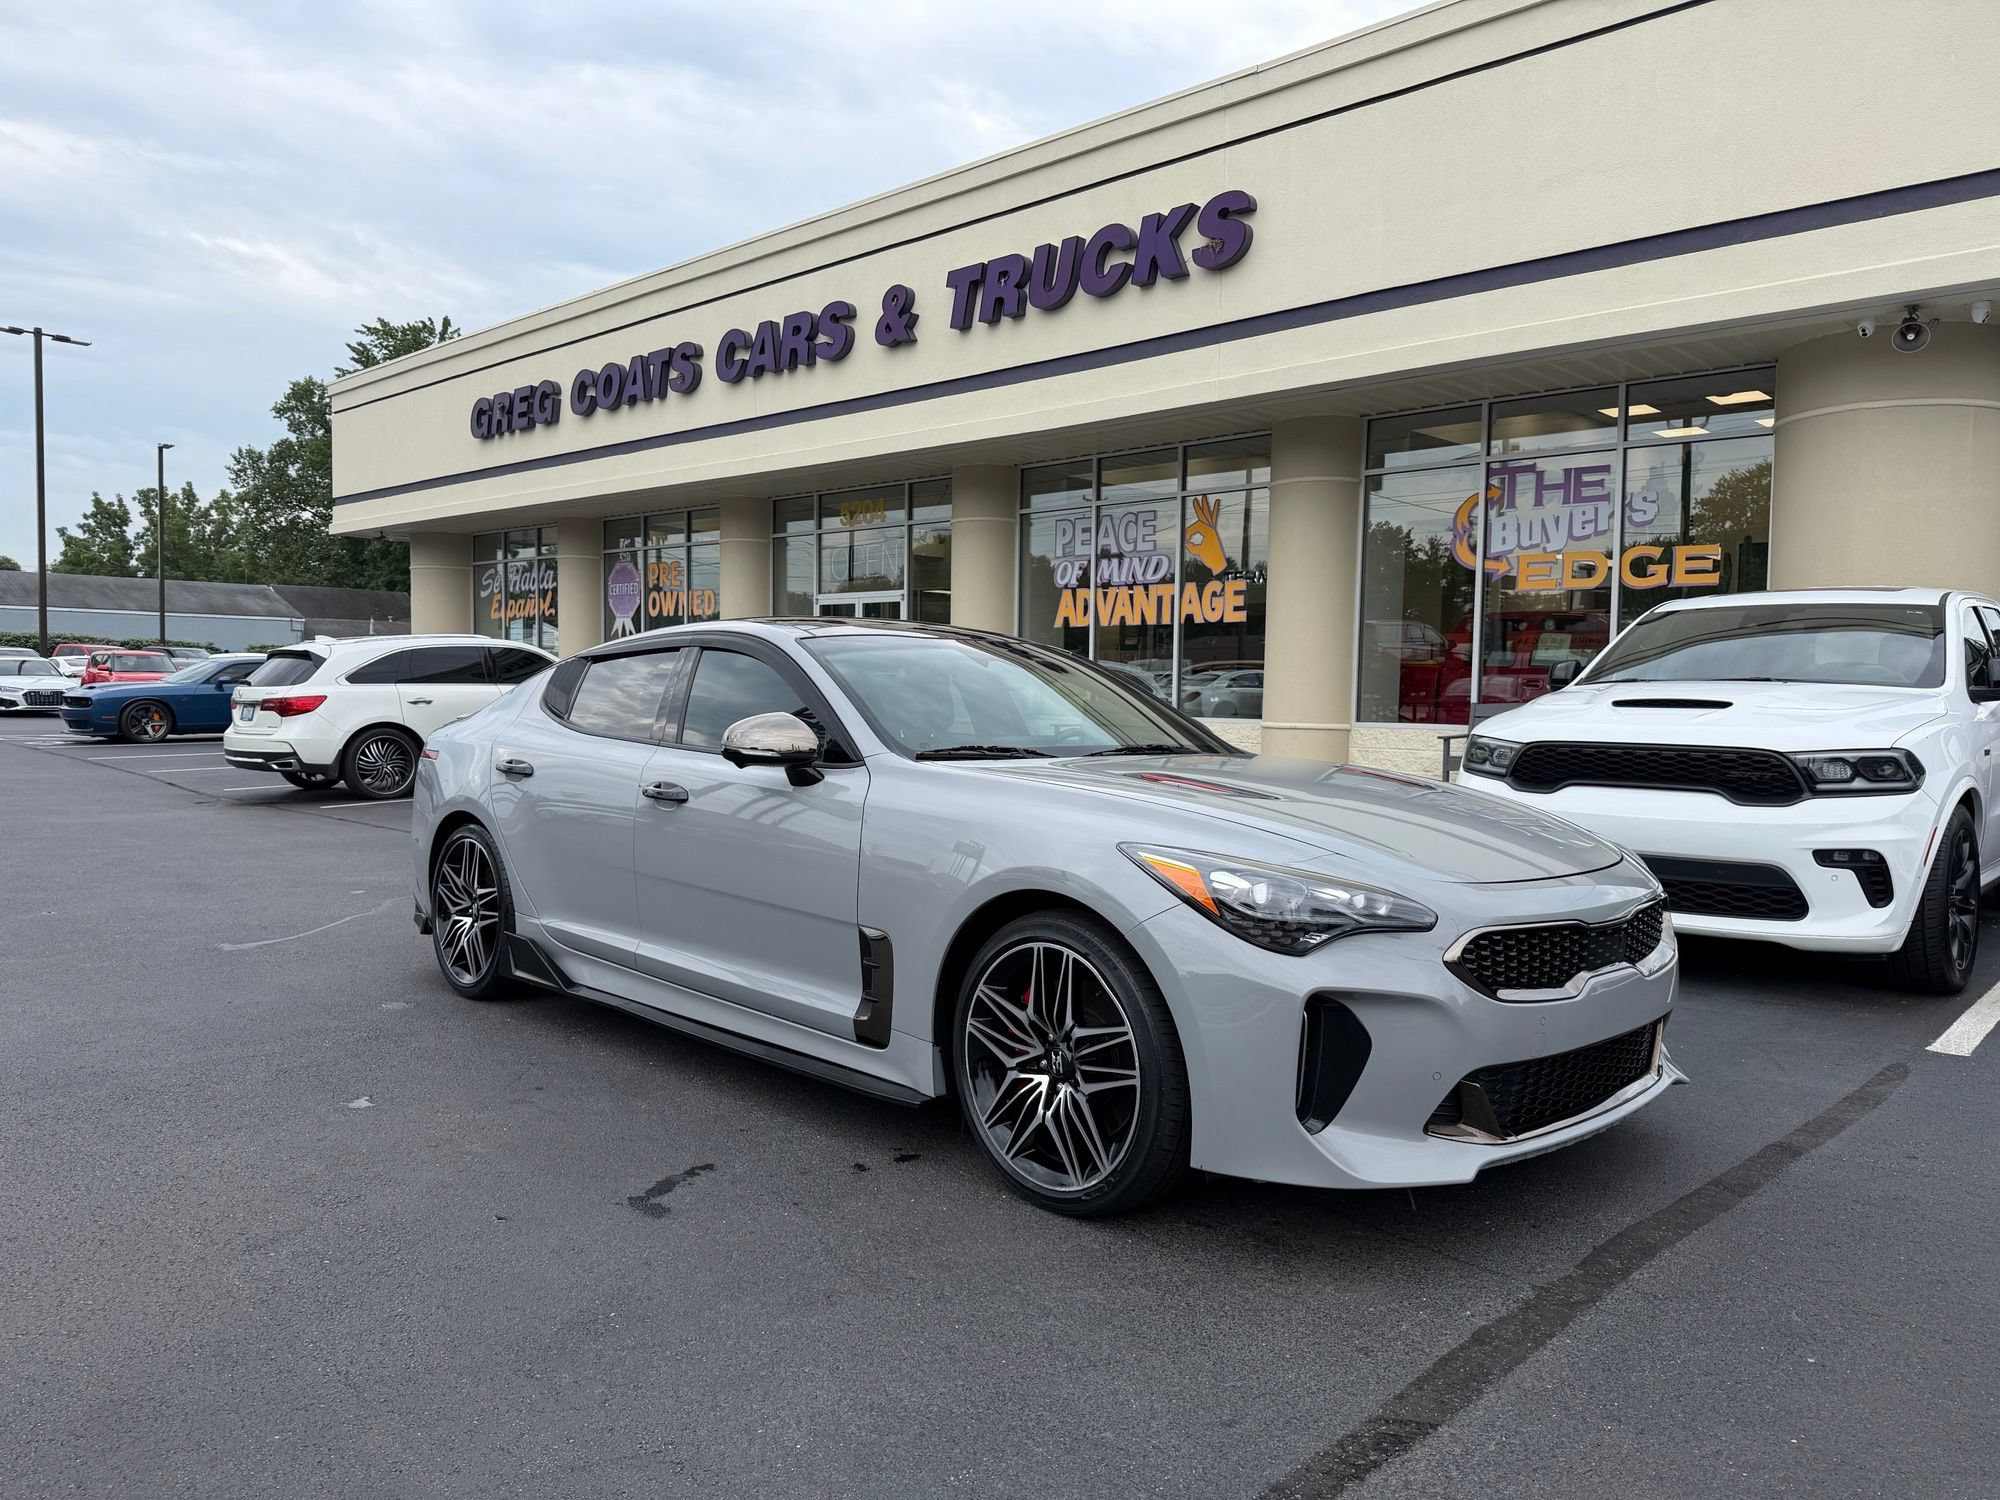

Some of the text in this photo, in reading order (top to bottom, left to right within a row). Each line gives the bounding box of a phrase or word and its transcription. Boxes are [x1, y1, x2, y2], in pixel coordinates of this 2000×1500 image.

[470, 189, 1258, 440] GREG COATS CARS & TRUCKS
[1488, 462, 1612, 510] THE
[1054, 510, 1157, 558] PEACE
[480, 562, 557, 598] Se Habla
[609, 582, 639, 596] CERTIFIED
[1052, 554, 1169, 588] OF MIND
[1515, 543, 1722, 592] EDGE
[648, 590, 716, 617] OWNED
[1054, 580, 1248, 628] ADVANTAGE
